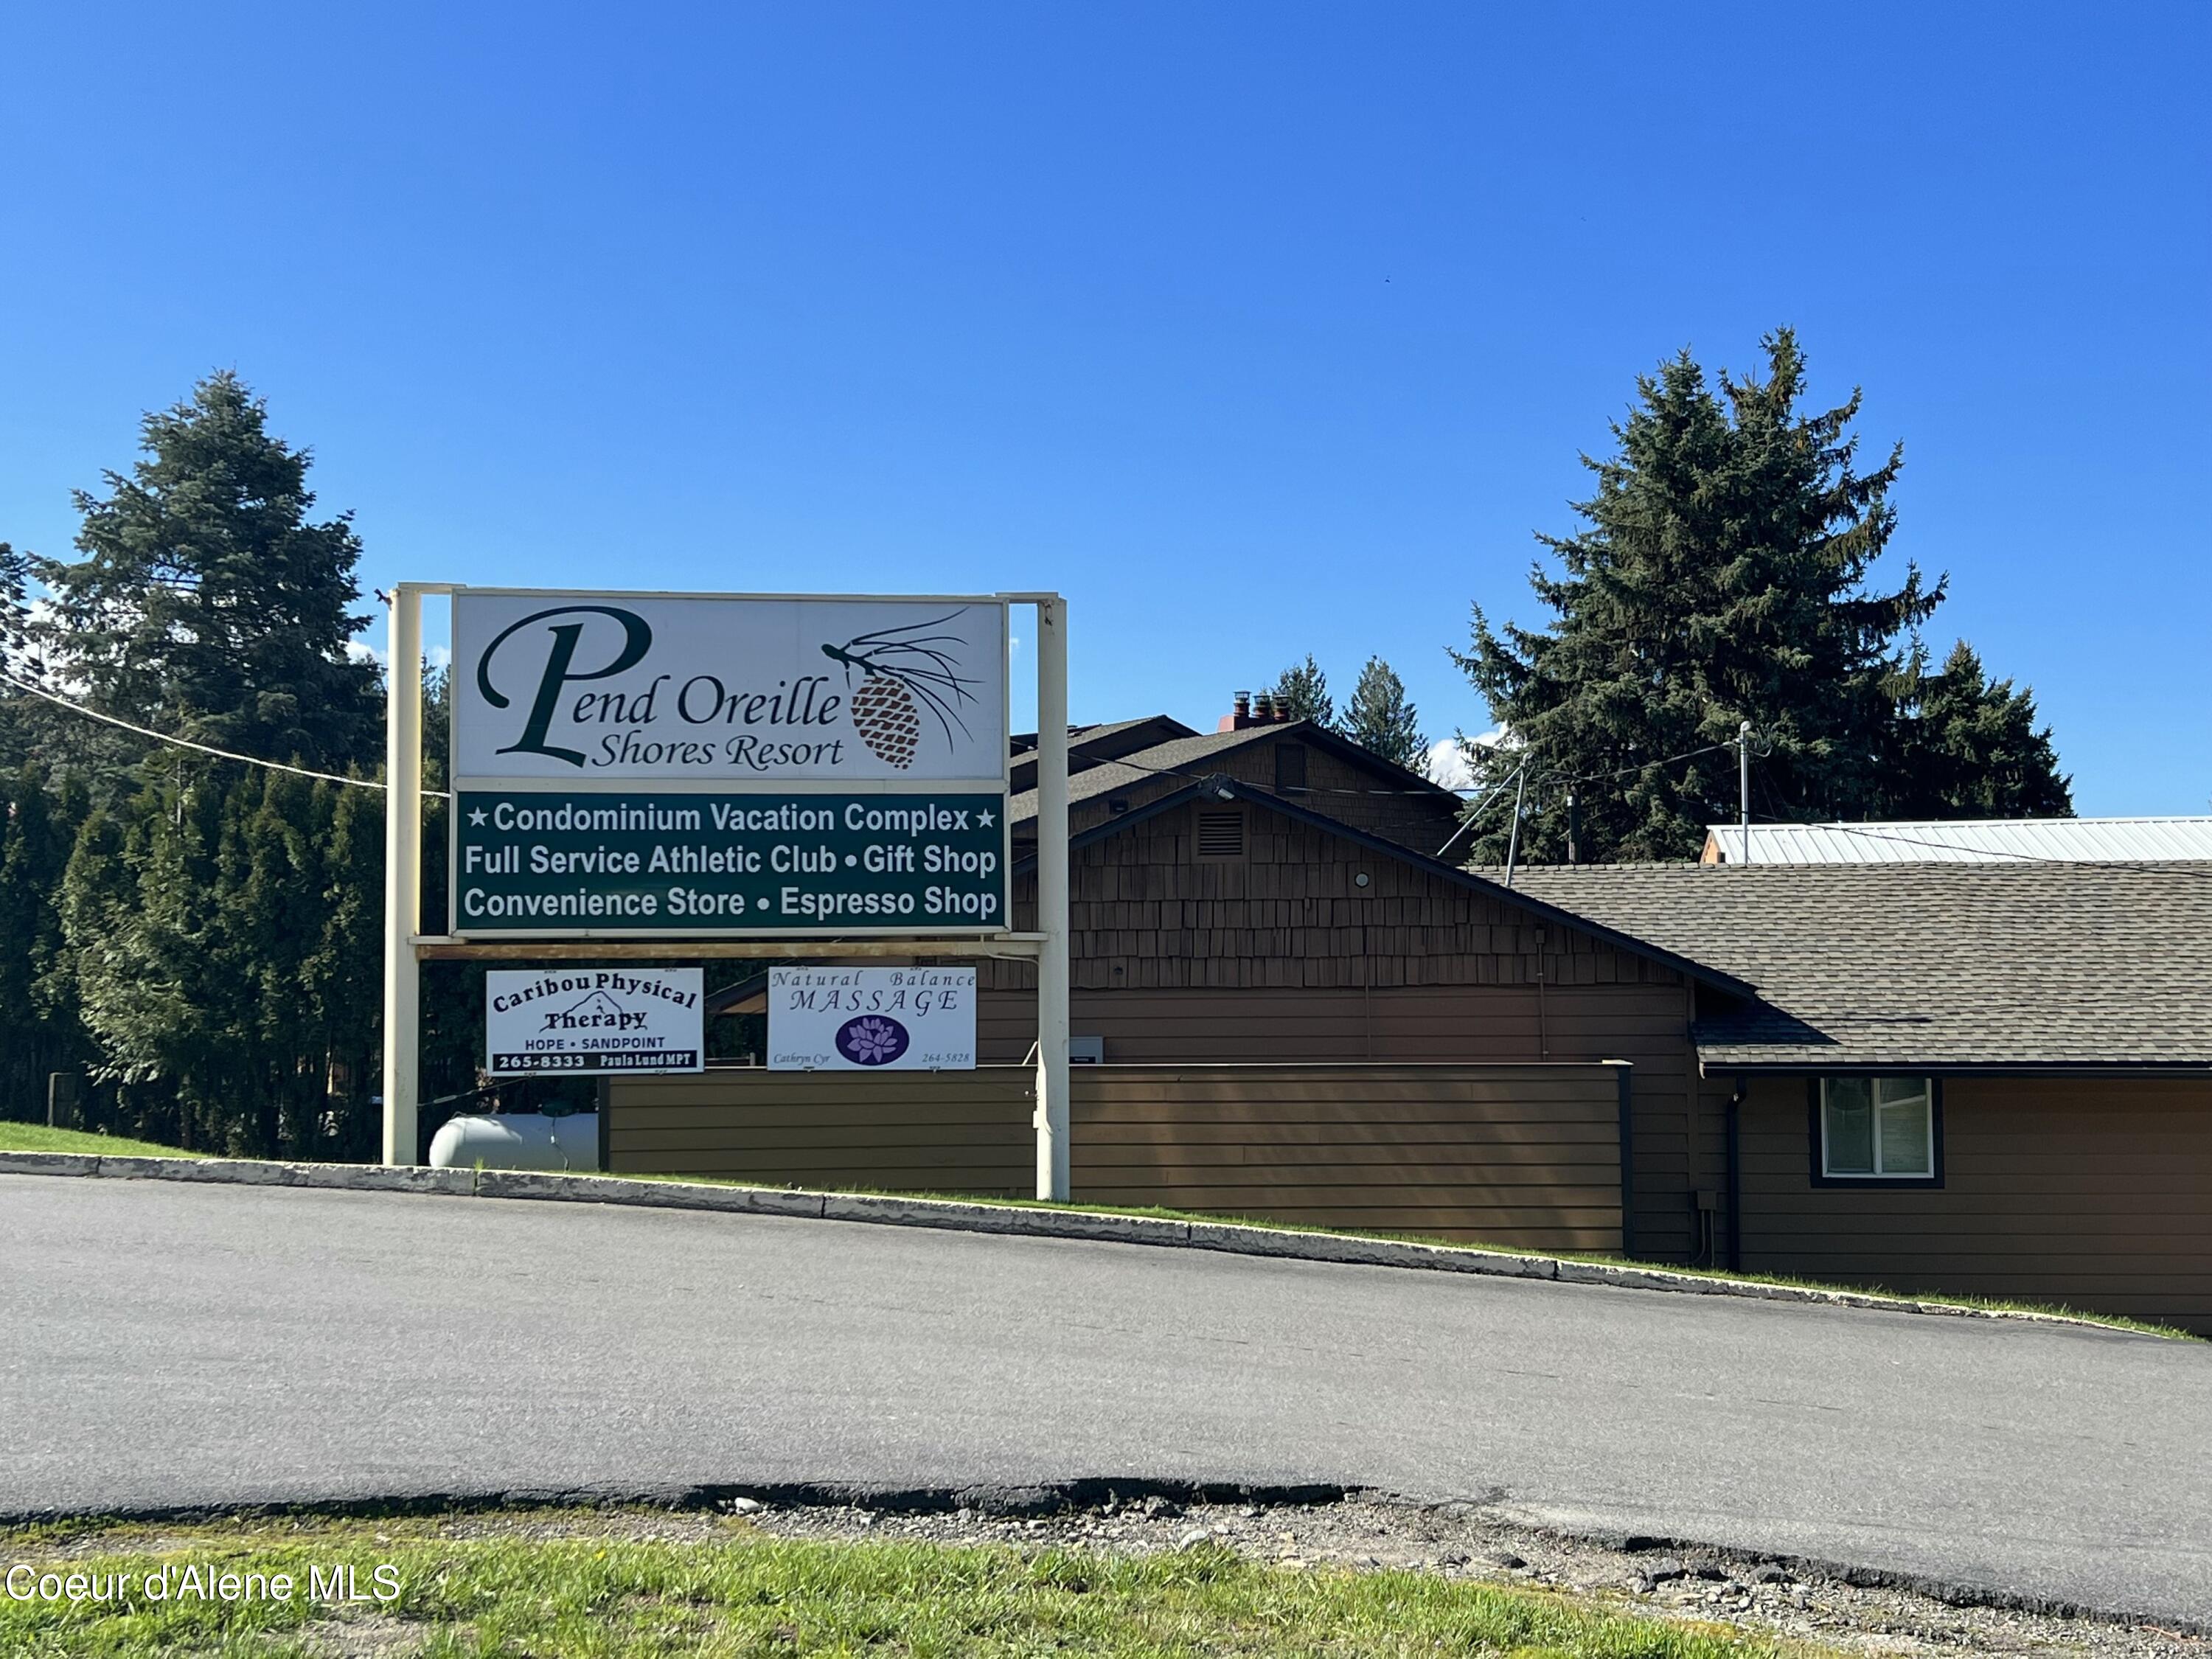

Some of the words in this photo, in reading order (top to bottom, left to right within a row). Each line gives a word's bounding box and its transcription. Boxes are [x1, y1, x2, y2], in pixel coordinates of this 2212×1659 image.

[477, 605, 671, 768] Pend
[678, 675, 841, 725] Oreille
[591, 729, 716, 767] Shores
[726, 735, 844, 771] Resort
[493, 802, 700, 831] Condominium
[710, 803, 835, 830] Vacation
[845, 803, 970, 837] Complex
[465, 846, 519, 873] Full
[529, 845, 641, 874] Service
[647, 845, 762, 874] Athletic
[771, 845, 838, 873] Club
[863, 845, 916, 873] Gift
[923, 845, 996, 879] Shop
[465, 888, 658, 916] Convenience
[667, 887, 745, 916] Store
[781, 887, 915, 921] Espresso
[924, 886, 997, 920] Shop
[771, 970, 863, 987] Natural
[889, 970, 975, 987] Balance
[493, 976, 591, 1012] Caribou
[595, 973, 697, 1009] Physical
[789, 990, 958, 1017] MASSAGE
[545, 1012, 647, 1030] Therapy
[525, 1039, 565, 1051] HOPE
[582, 1037, 666, 1049] SANDPOINT
[499, 1055, 585, 1068] 265-8333
[599, 1054, 634, 1067] Paula
[635, 1054, 664, 1066] Lund
[665, 1053, 692, 1065] MPT
[773, 1052, 811, 1066] Cathryn
[813, 1053, 832, 1066] Cyr
[922, 1053, 970, 1062] 264-5828
